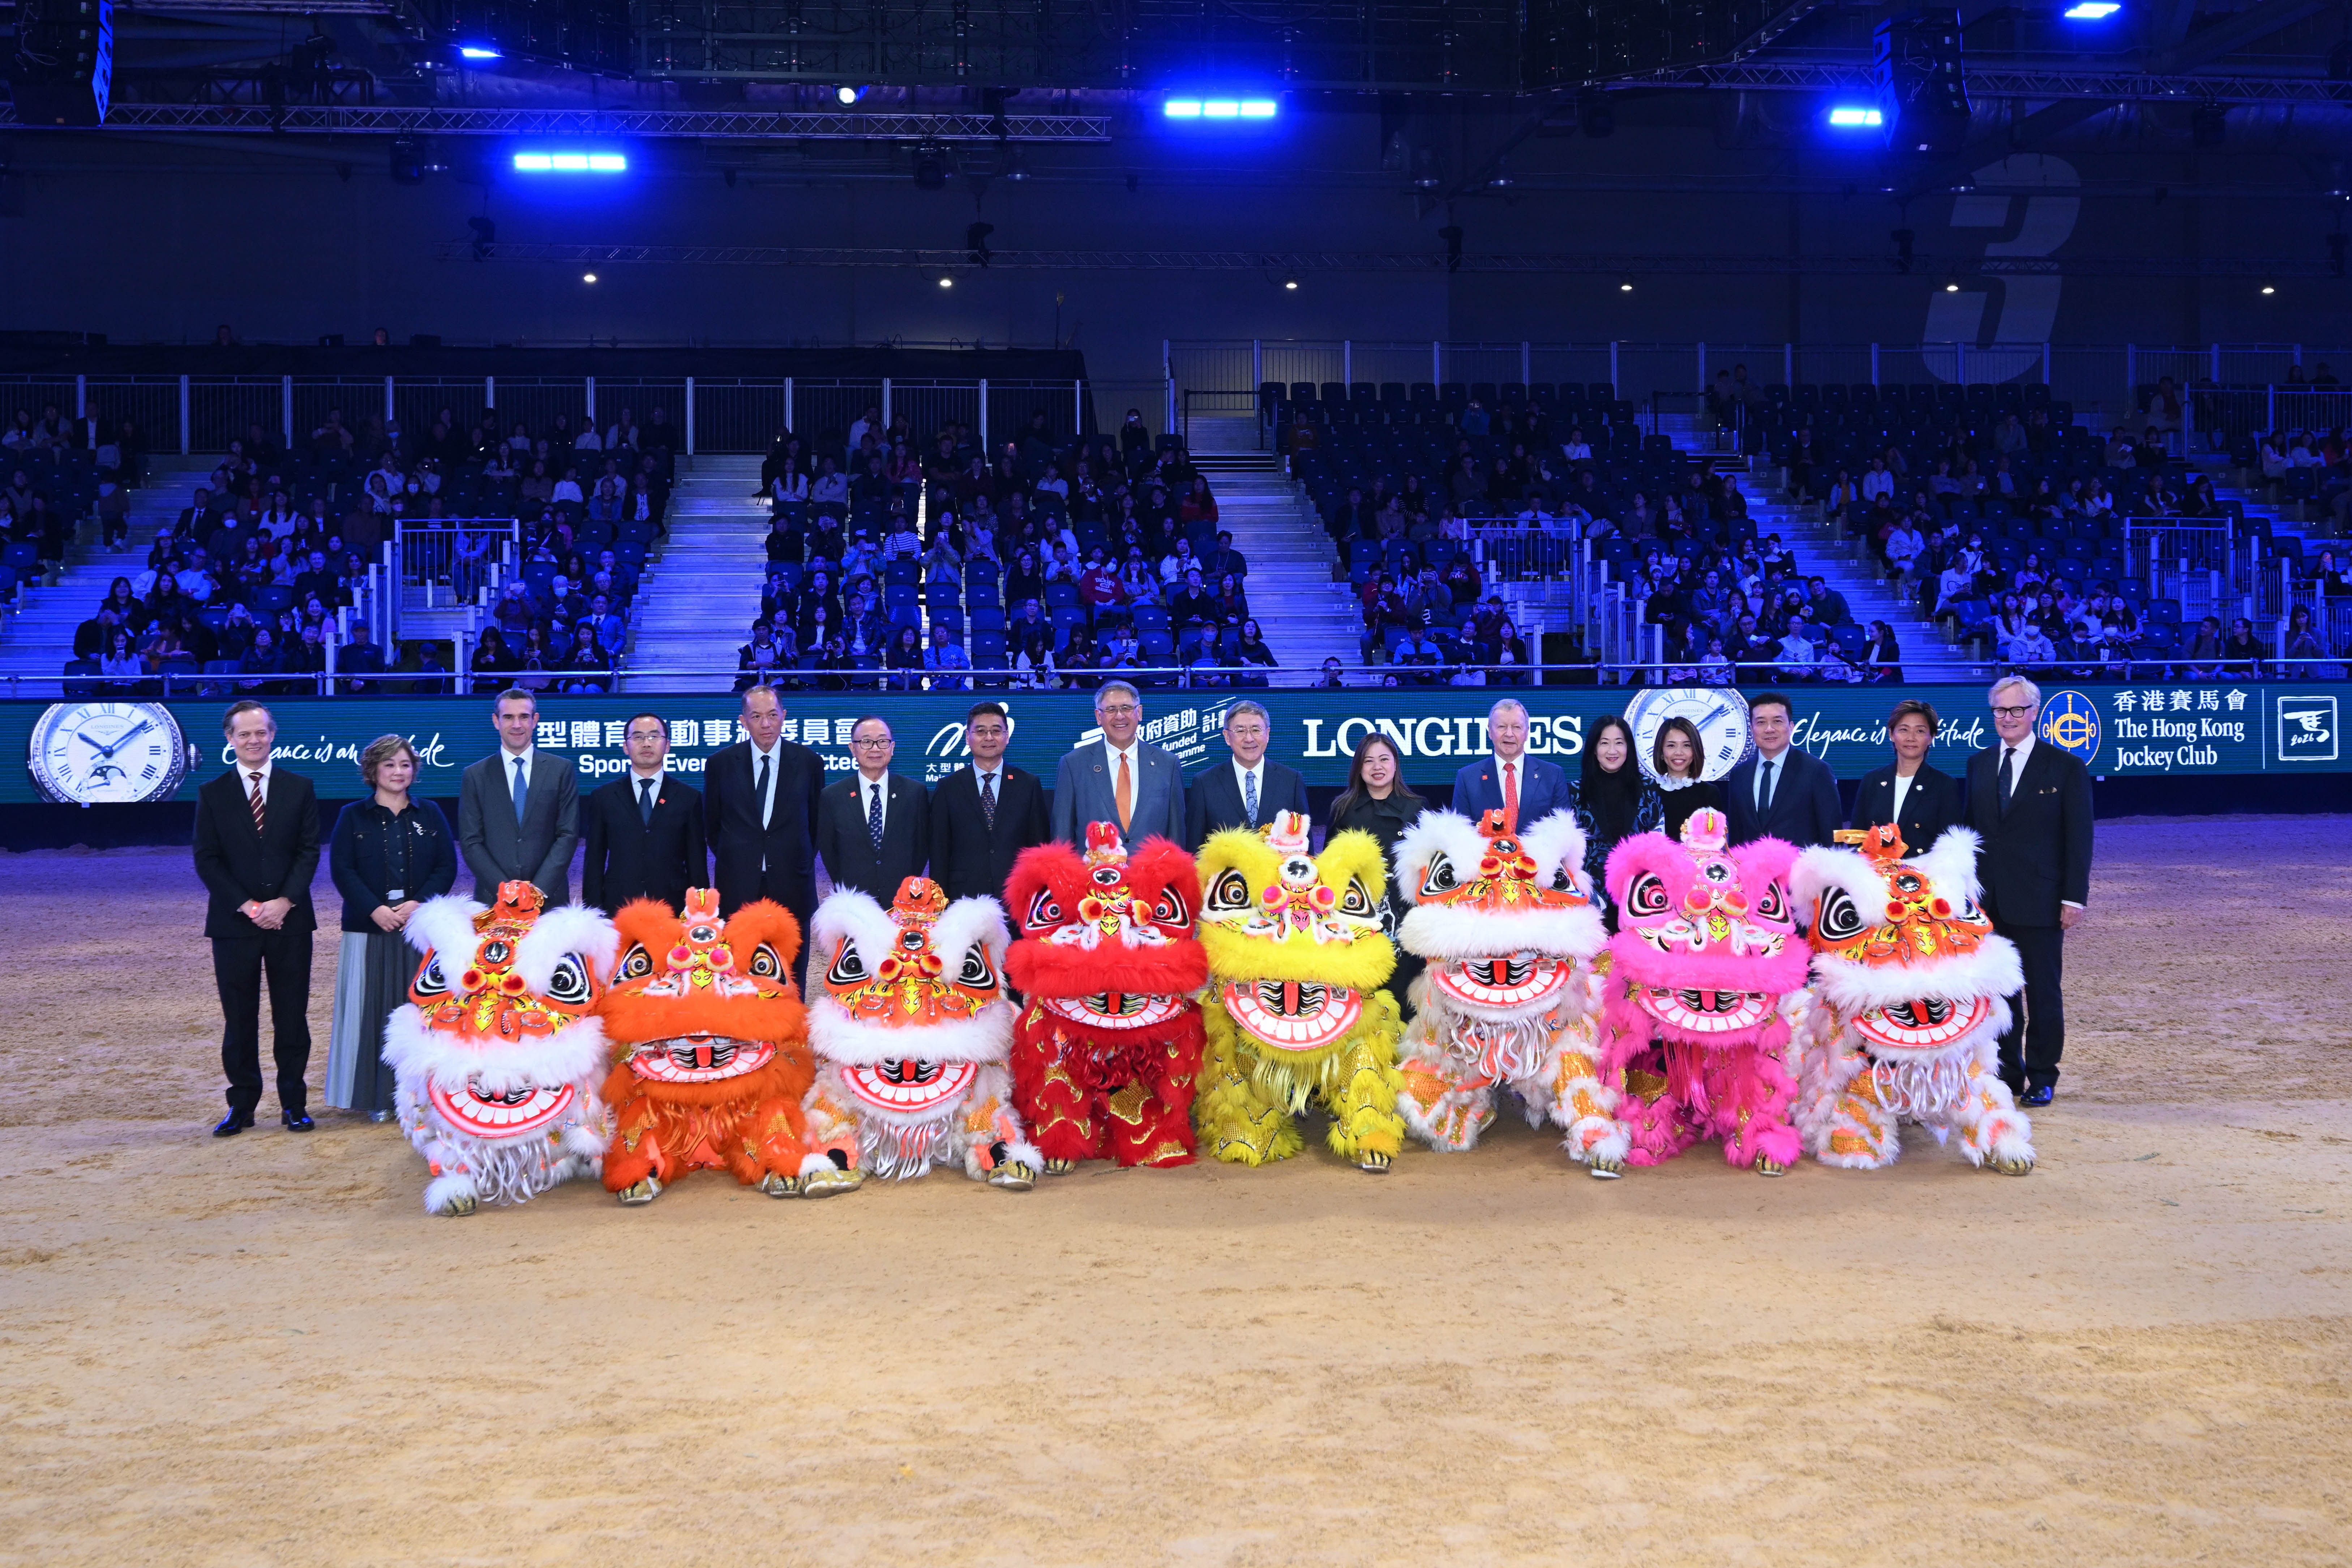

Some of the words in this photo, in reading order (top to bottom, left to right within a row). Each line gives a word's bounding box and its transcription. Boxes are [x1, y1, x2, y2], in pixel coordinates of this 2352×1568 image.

[1923, 153, 2081, 384] 3
[1095, 578, 1115, 587] DICKIES
[2113, 689, 2248, 712] 香港賽馬會
[537, 718, 859, 747] 型體育動事委員會
[1790, 711, 1868, 759] Elegance
[1870, 719, 1887, 745] is
[2115, 717, 2148, 738] The
[2151, 719, 2197, 742] Hong
[2200, 718, 2245, 742] Kong
[2290, 733, 2314, 746] 2026
[315, 736, 334, 763] is
[2114, 745, 2175, 771] Jockey
[2177, 744, 2218, 765] Club
[579, 754, 632, 778] Spor
[926, 763, 966, 773] 大型體
